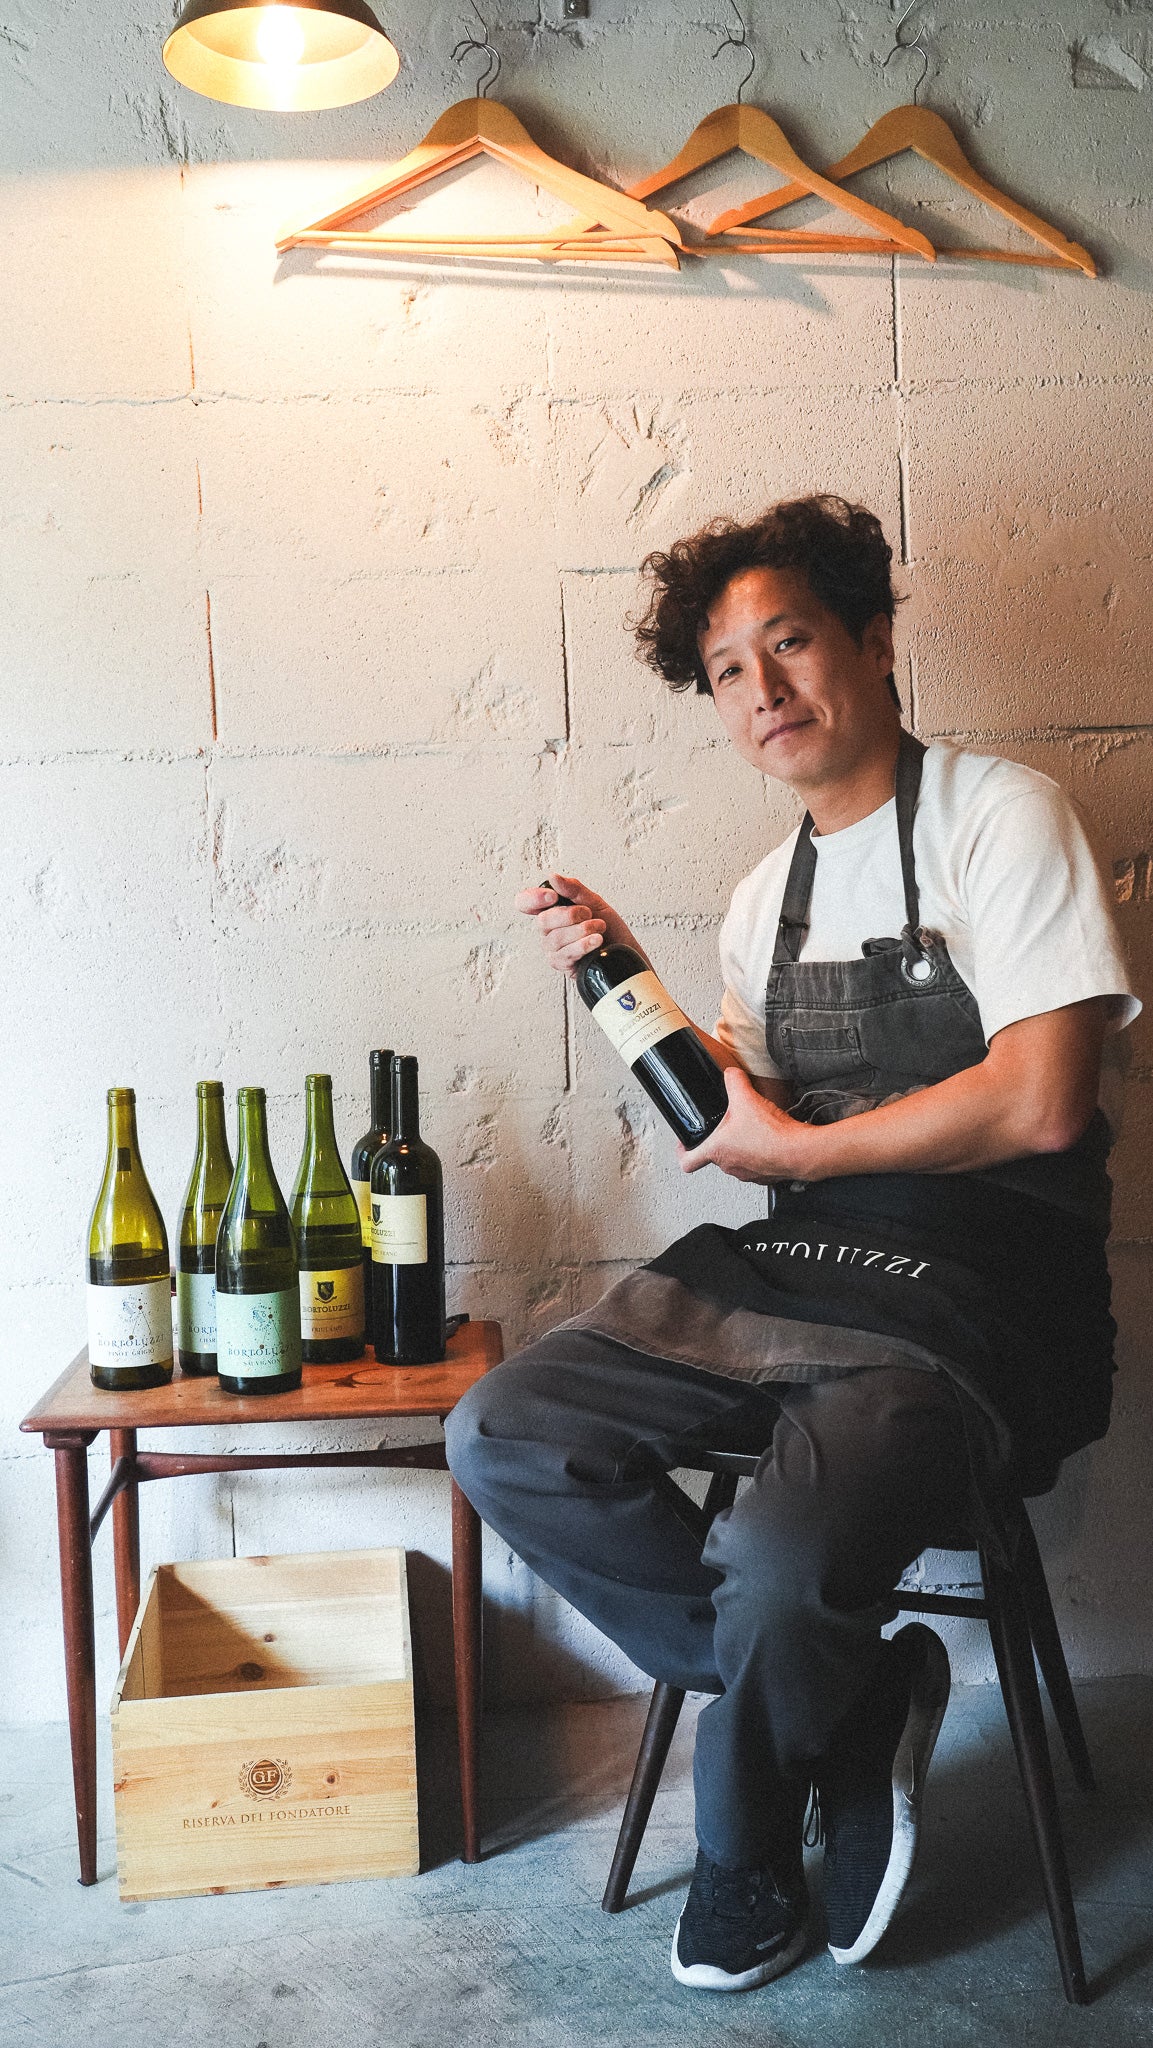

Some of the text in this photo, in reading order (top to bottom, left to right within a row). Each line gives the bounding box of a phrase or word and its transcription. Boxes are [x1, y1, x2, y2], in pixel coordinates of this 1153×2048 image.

[302, 1303, 351, 1313] BORTOLUZZI
[98, 1333, 165, 1348] BORTOLUZZI
[252, 1769, 279, 1785] GF
[183, 1816, 237, 1830] RISERVA
[270, 1804, 351, 1821] FONDATORE
